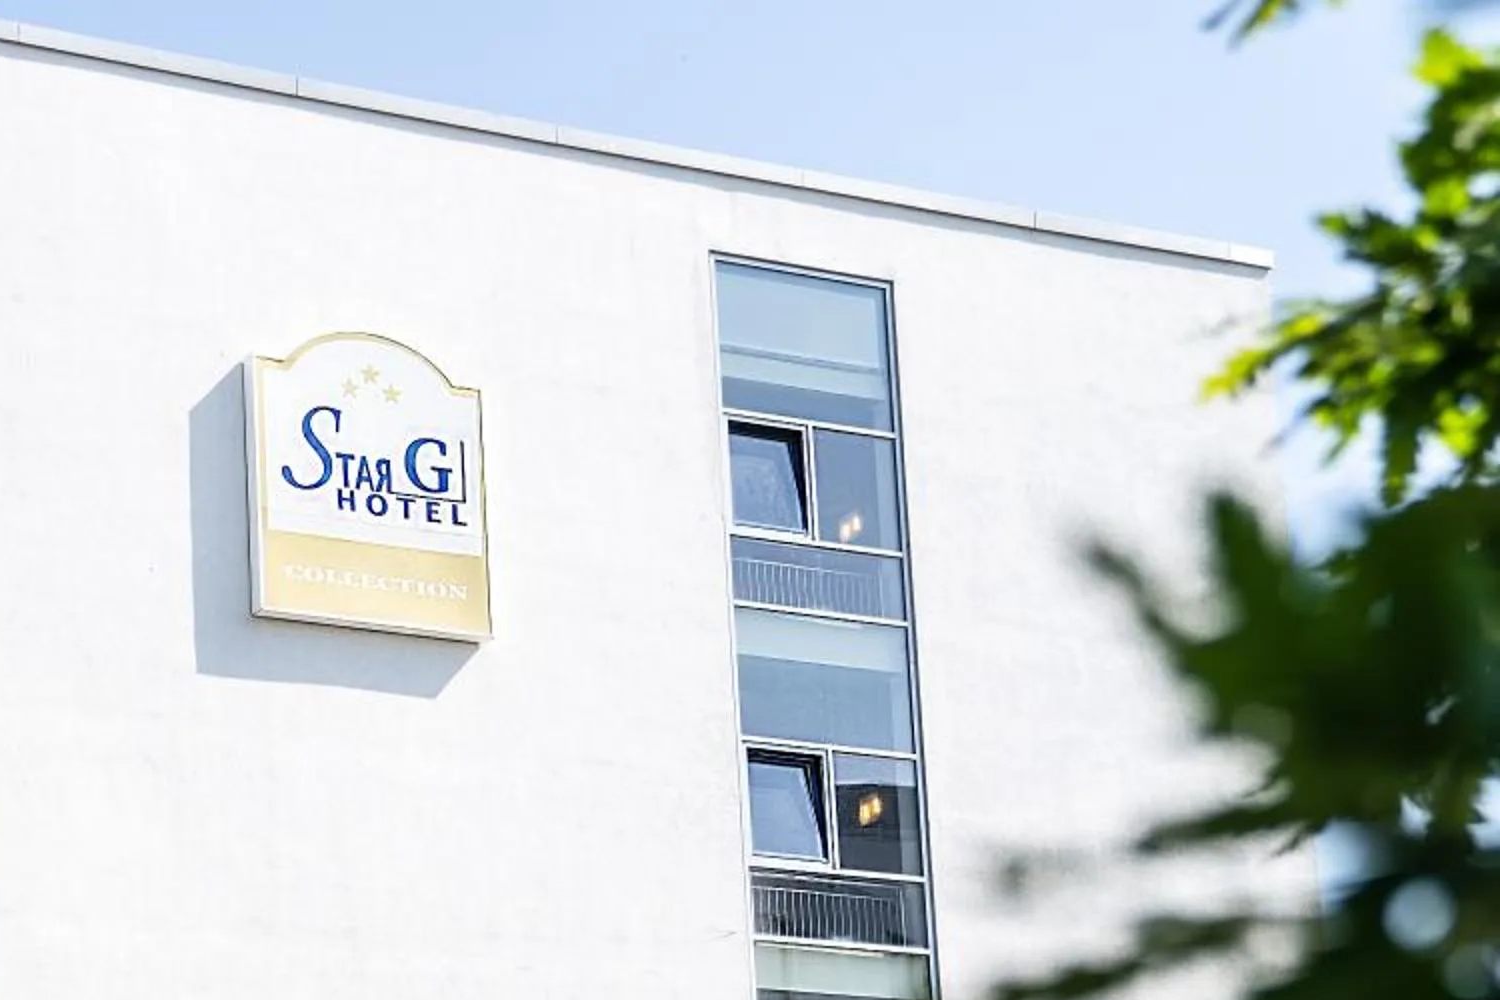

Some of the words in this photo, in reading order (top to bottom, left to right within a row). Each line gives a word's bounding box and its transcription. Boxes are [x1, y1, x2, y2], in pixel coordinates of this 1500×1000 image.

[404, 437, 453, 494] G
[336, 488, 469, 527] HOTEL
[284, 563, 469, 601] COLLECTION
